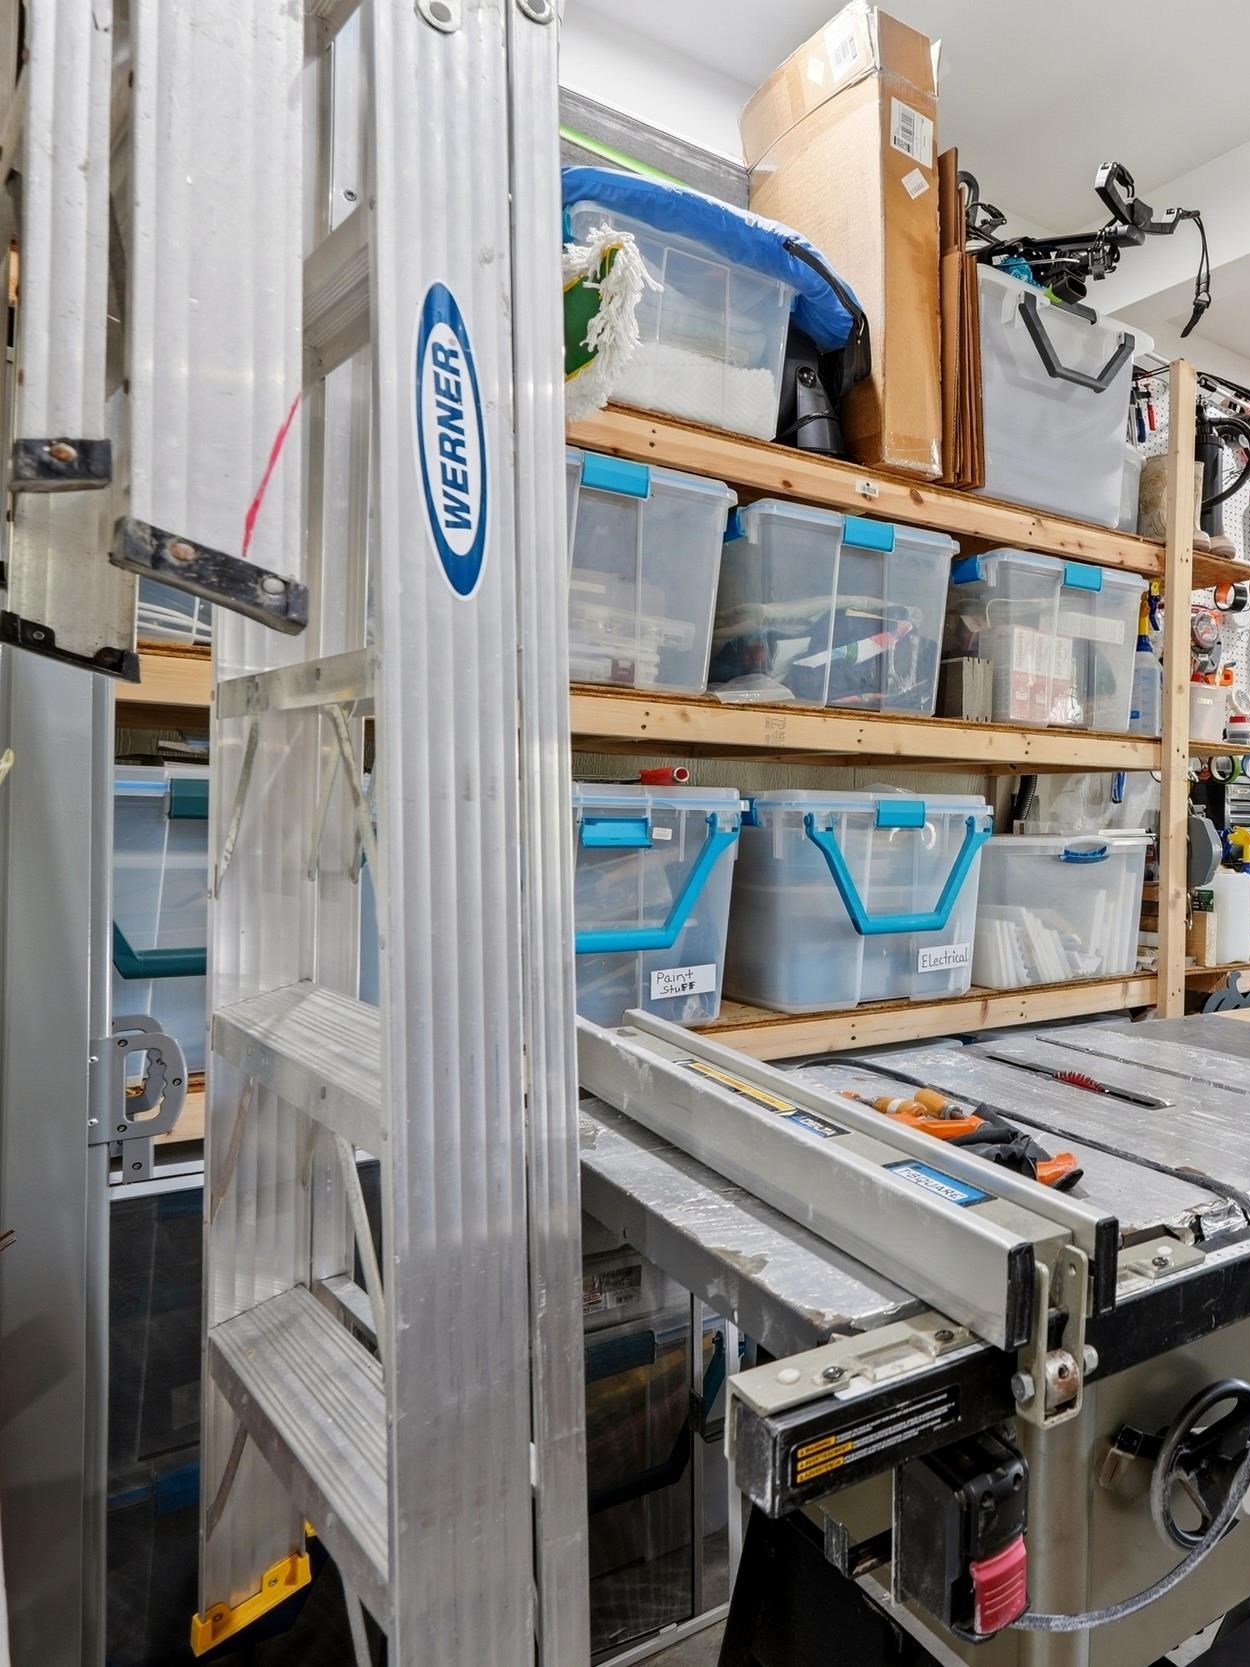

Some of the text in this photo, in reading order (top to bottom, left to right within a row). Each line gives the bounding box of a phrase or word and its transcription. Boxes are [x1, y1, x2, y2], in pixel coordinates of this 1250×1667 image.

[432, 341, 472, 530] WERNER
[657, 969, 694, 984] Paint
[899, 1168, 965, 1200] T-SQUARE
